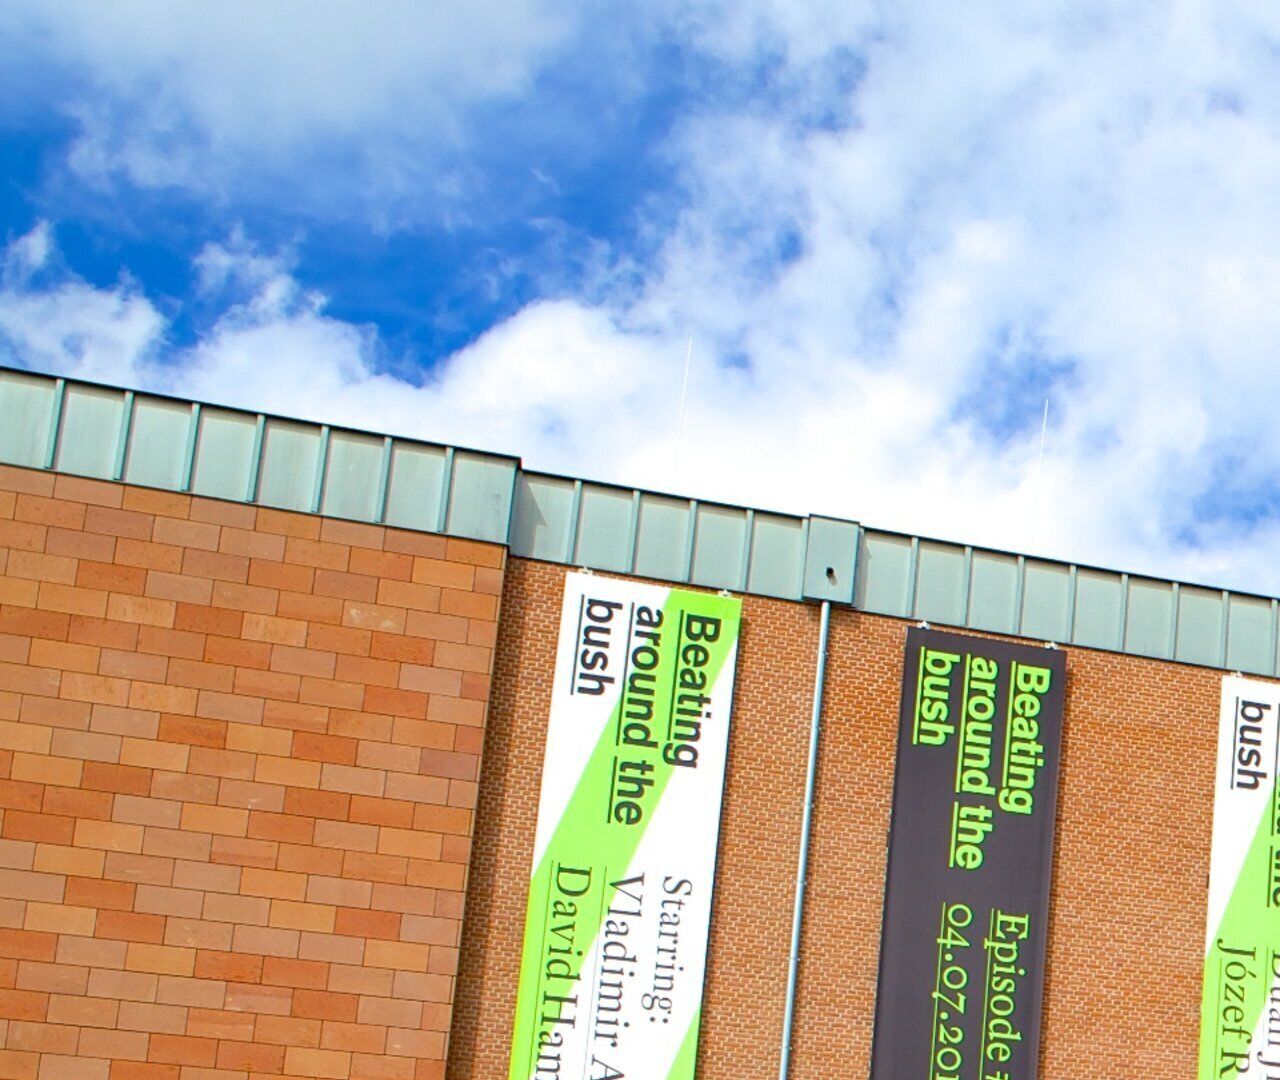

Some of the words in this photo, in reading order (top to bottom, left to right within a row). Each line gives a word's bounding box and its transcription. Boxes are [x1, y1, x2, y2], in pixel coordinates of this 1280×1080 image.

[576, 598, 623, 695] bush
[622, 606, 664, 749] around
[662, 613, 721, 768] Beating
[919, 649, 961, 746] bush
[961, 656, 998, 796] around
[998, 664, 1052, 815] Beating
[1236, 700, 1271, 791] bush
[613, 760, 655, 826] the
[955, 805, 993, 870] the
[545, 863, 592, 981] David
[593, 872, 646, 1049] Vladimir
[641, 875, 693, 1025] Starring:
[984, 909, 1029, 1062] Episode
[1216, 938, 1257, 1044] Józef
